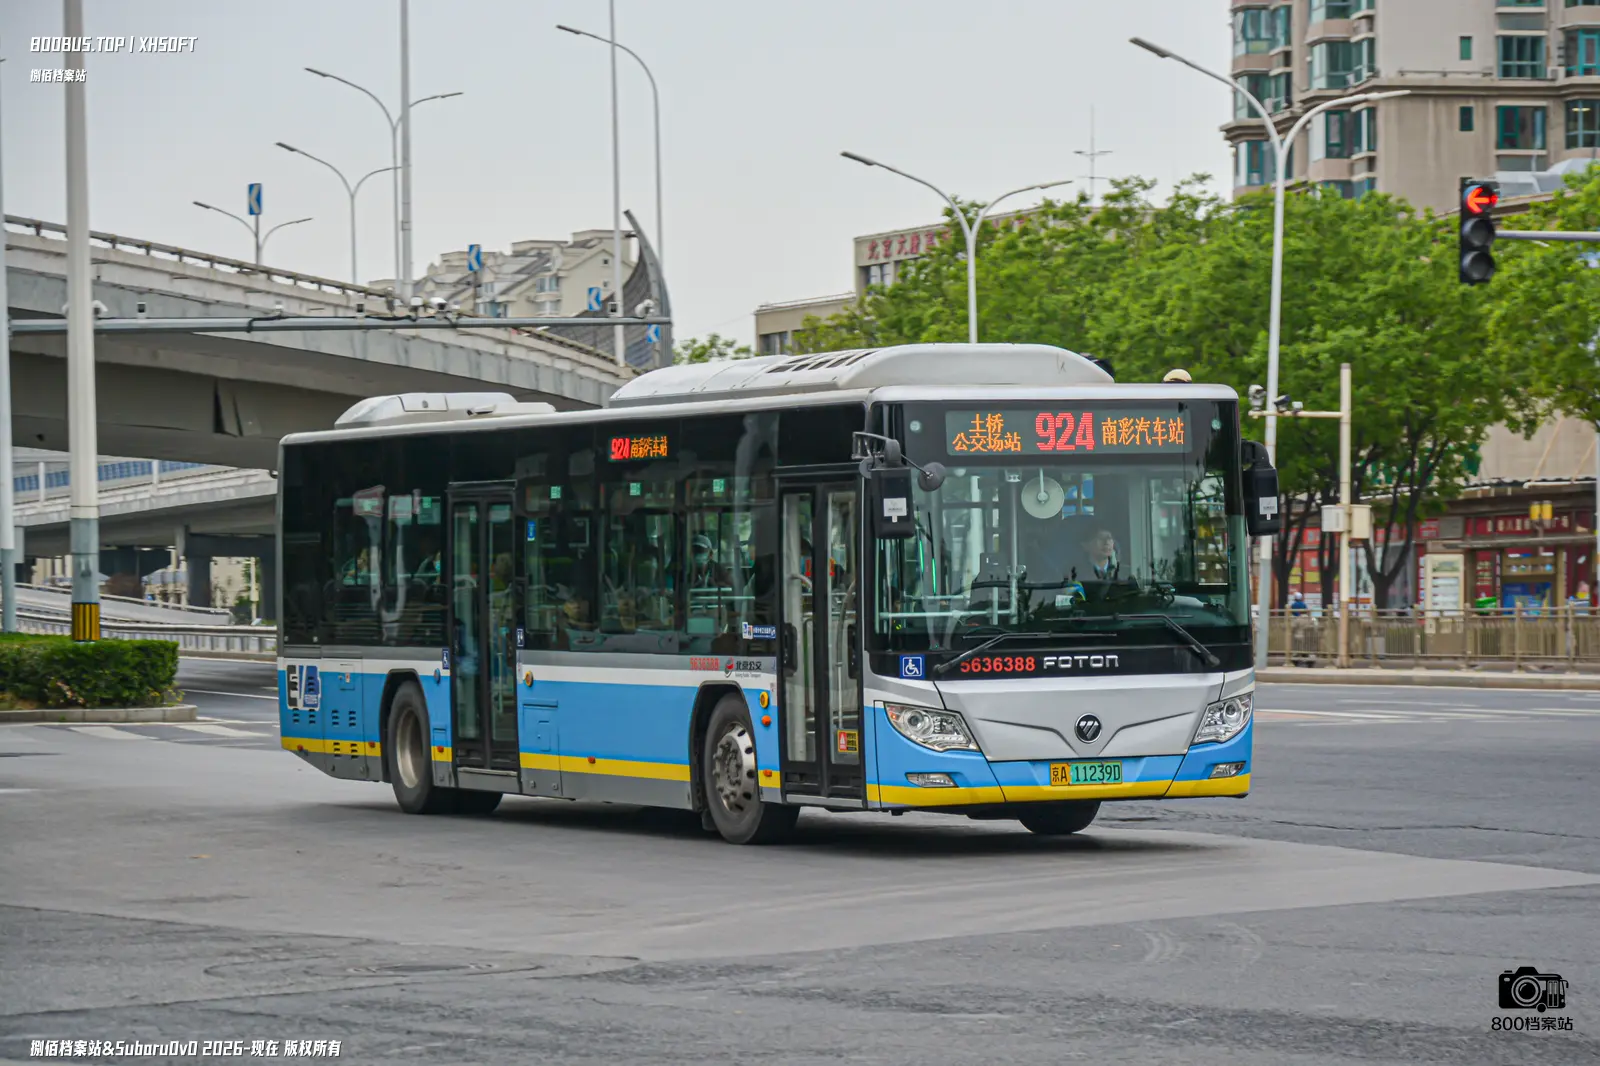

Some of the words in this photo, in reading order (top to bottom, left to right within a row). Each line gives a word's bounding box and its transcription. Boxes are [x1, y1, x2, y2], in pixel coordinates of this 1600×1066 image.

[969, 413, 1004, 433] 土桥
[1035, 412, 1096, 451] 924
[1101, 417, 1185, 446] 南彩汽车站
[952, 431, 1022, 452] 公交场站
[735, 661, 762, 671] 北京公交
[960, 656, 1036, 673] 5636388
[1043, 655, 1119, 669] FOTON
